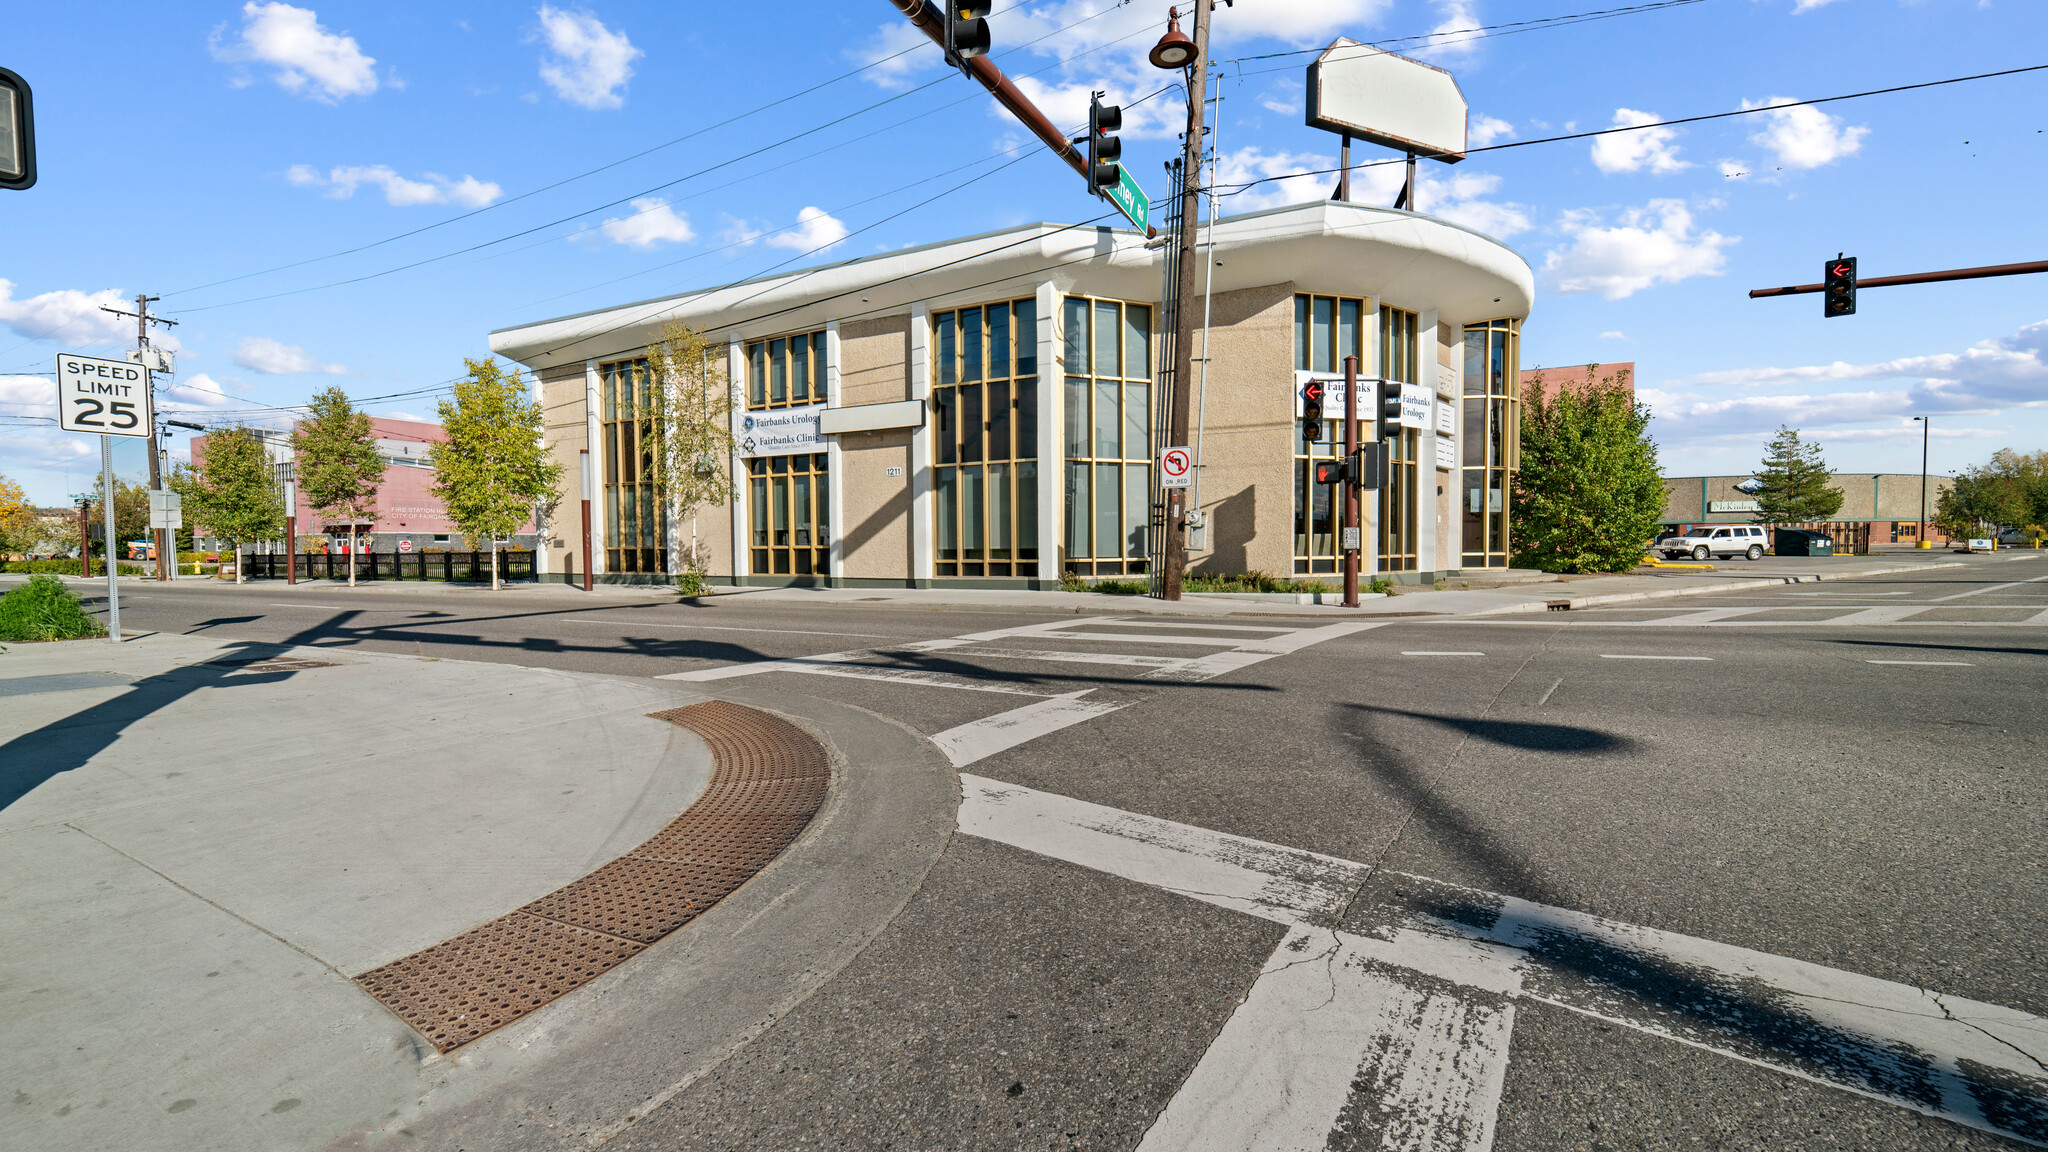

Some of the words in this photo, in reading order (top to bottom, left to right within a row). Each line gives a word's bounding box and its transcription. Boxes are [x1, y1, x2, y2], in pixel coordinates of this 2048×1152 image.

[1137, 203, 1144, 222] Rd
[67, 362, 138, 381] SPEED
[77, 380, 131, 397] LIMIT
[1327, 381, 1371, 393] Fairnks
[1335, 393, 1362, 403] Clc
[1402, 394, 1431, 407] Fairbanks
[74, 398, 139, 429] 25
[1402, 406, 1425, 421] Urology
[756, 416, 790, 427] Fairbanks
[792, 414, 820, 424] Urology
[760, 435, 795, 446] Fairbanks
[796, 433, 819, 442] Clinic
[1713, 501, 1753, 511] McKinley
